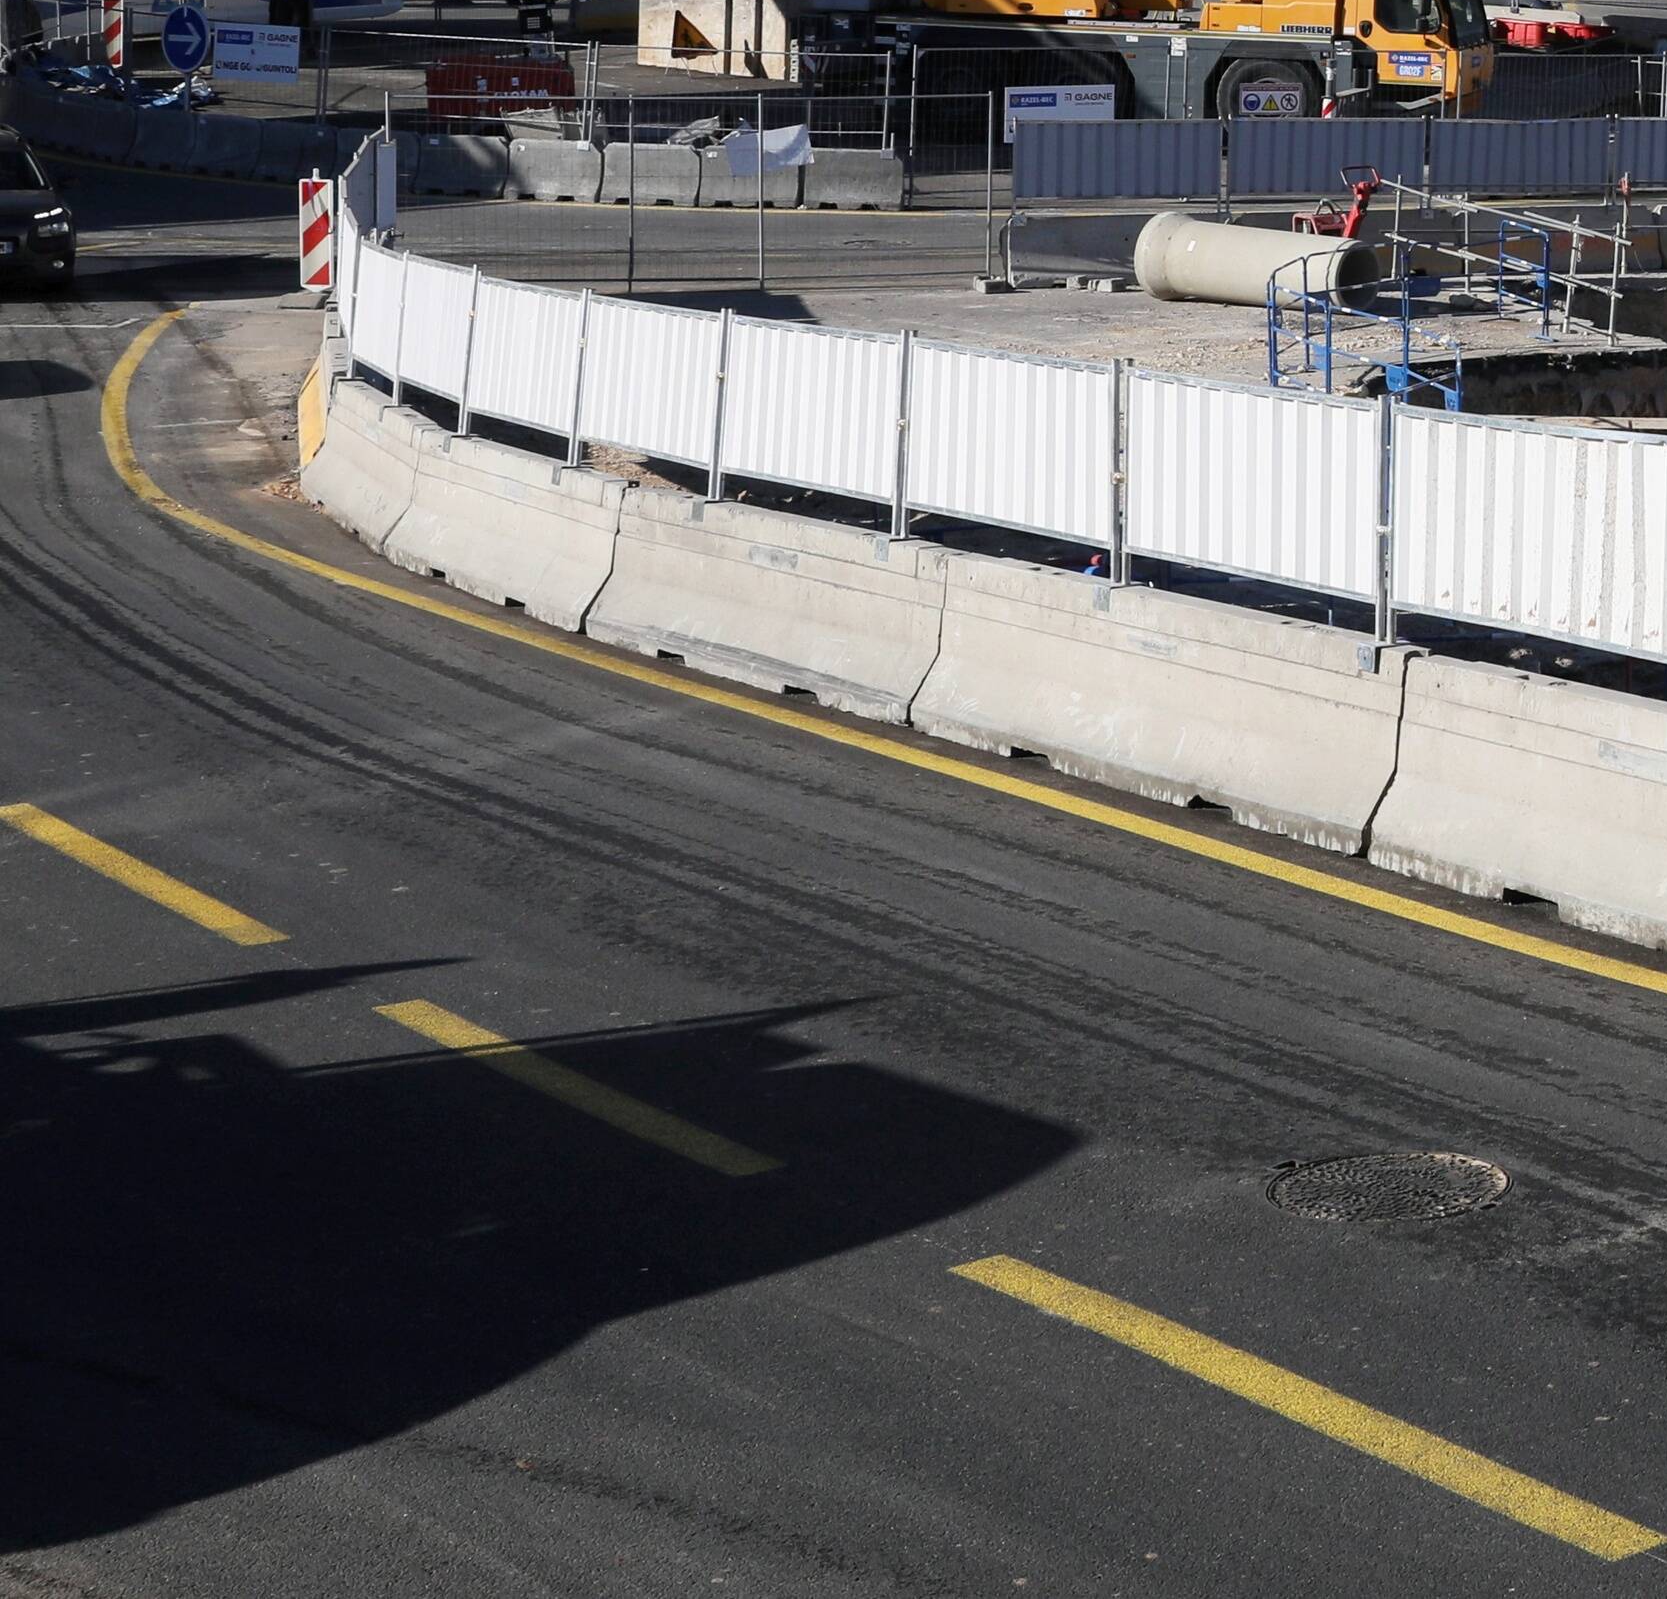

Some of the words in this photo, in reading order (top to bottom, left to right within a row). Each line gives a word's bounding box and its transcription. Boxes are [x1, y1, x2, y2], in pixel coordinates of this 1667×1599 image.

[1281, 25, 1333, 35] LIEBHERR
[266, 33, 299, 43] GAGNE
[1074, 92, 1113, 101] GAGNE
